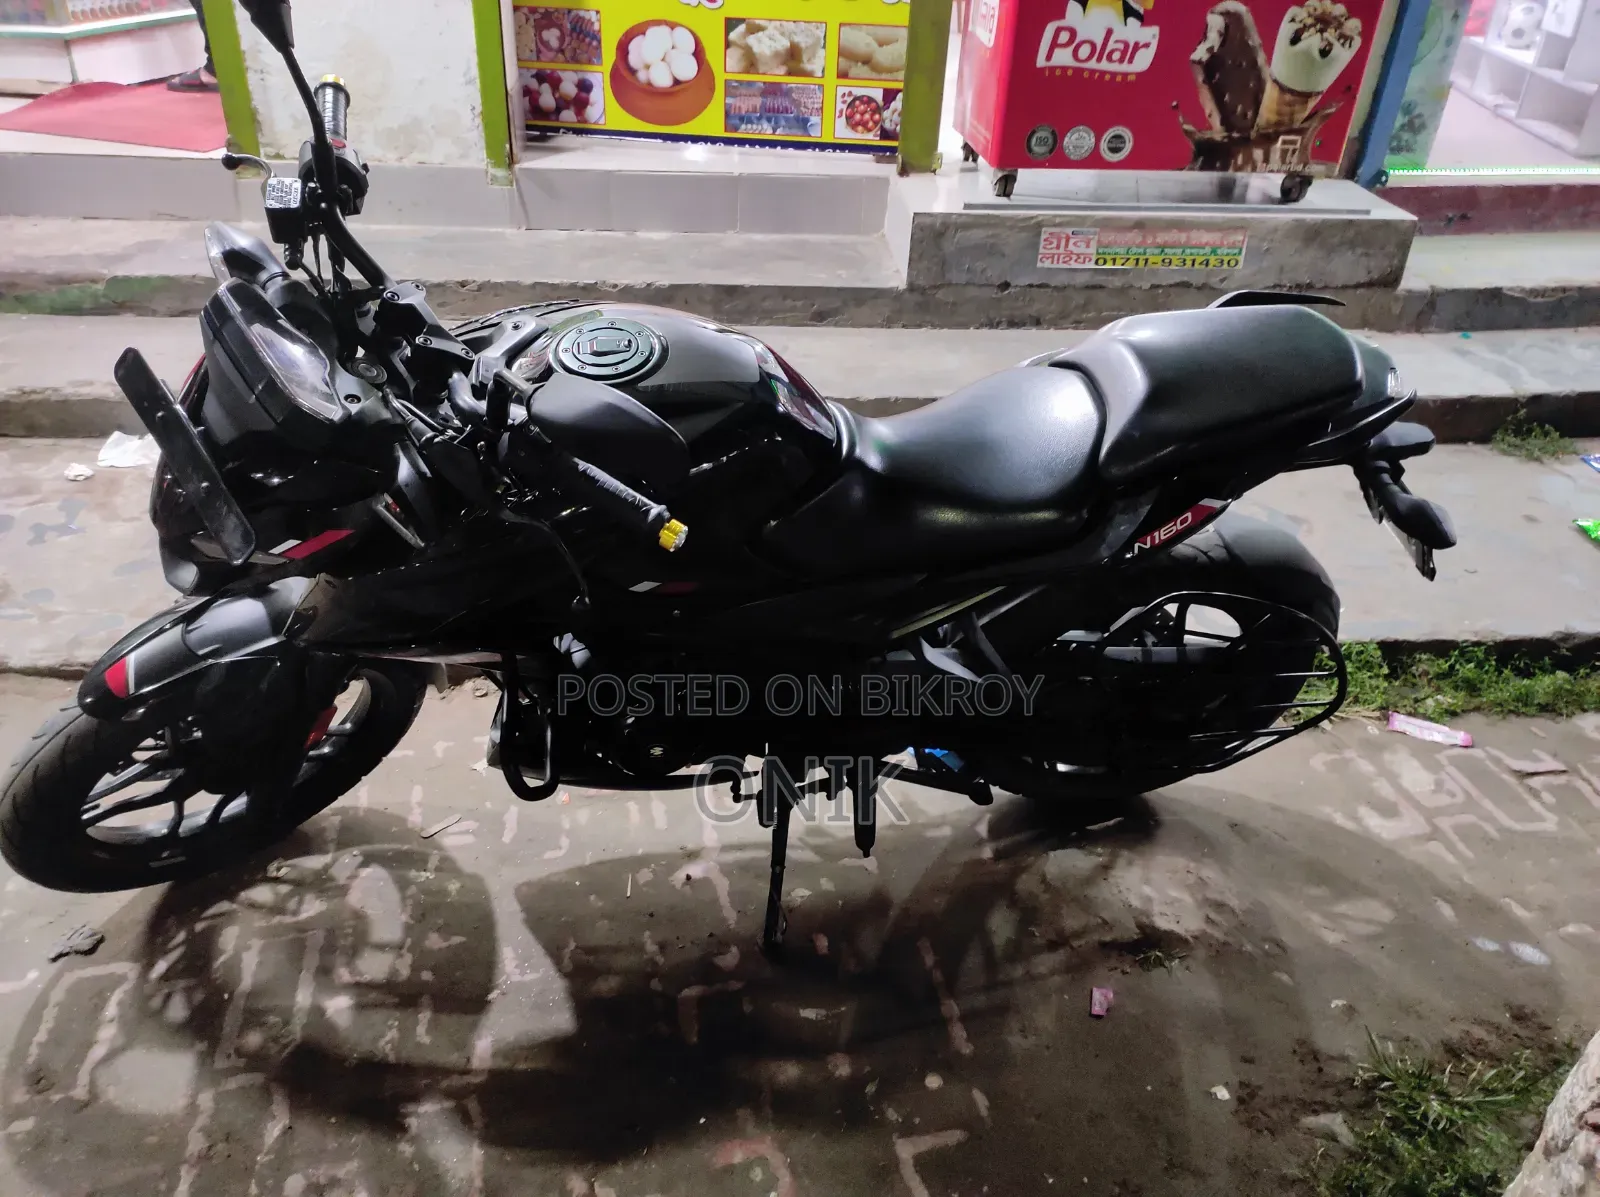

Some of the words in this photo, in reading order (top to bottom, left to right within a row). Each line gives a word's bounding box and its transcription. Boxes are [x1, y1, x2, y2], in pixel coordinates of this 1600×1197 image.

[1045, 26, 1151, 68] Polar
[1083, 70, 1137, 82] cream
[1094, 256, 1240, 268] 01711-931430
[1133, 511, 1192, 556] N160
